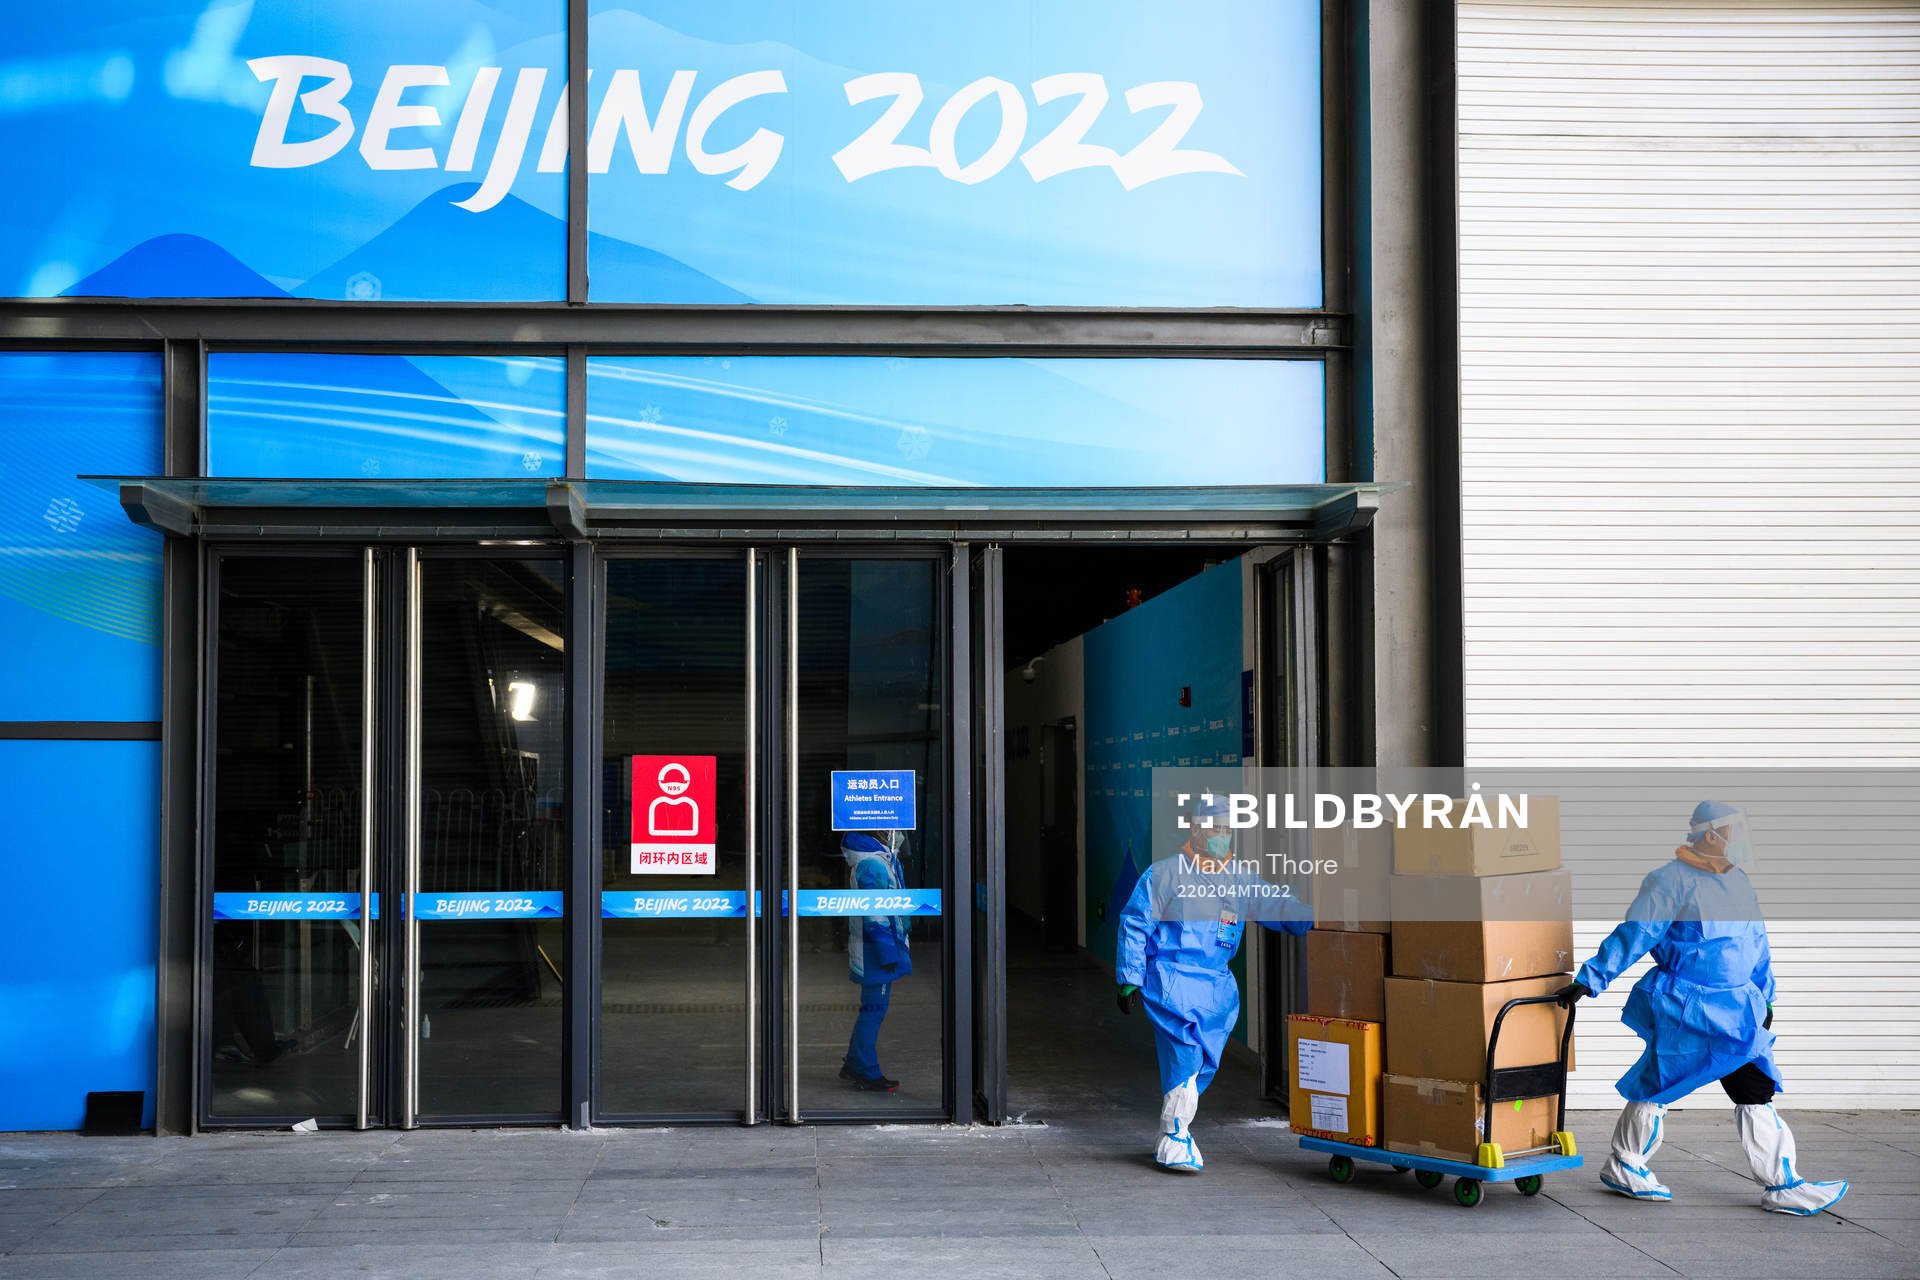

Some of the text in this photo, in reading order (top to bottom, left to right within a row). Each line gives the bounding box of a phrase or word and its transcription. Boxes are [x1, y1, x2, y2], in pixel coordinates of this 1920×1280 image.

[246, 55, 1248, 213] BEIJING 2022
[847, 778, 899, 790] 运动员入口
[844, 794, 904, 802] Athletes Entrance
[1510, 844, 1529, 852] SWEDEN
[639, 851, 708, 865] 闭环内区域
[247, 899, 350, 916] BEIJING 2022
[436, 898, 538, 917] BEIJING 2022
[634, 897, 733, 915] BEIJING 2022
[816, 895, 915, 913] BEIJING 2022
